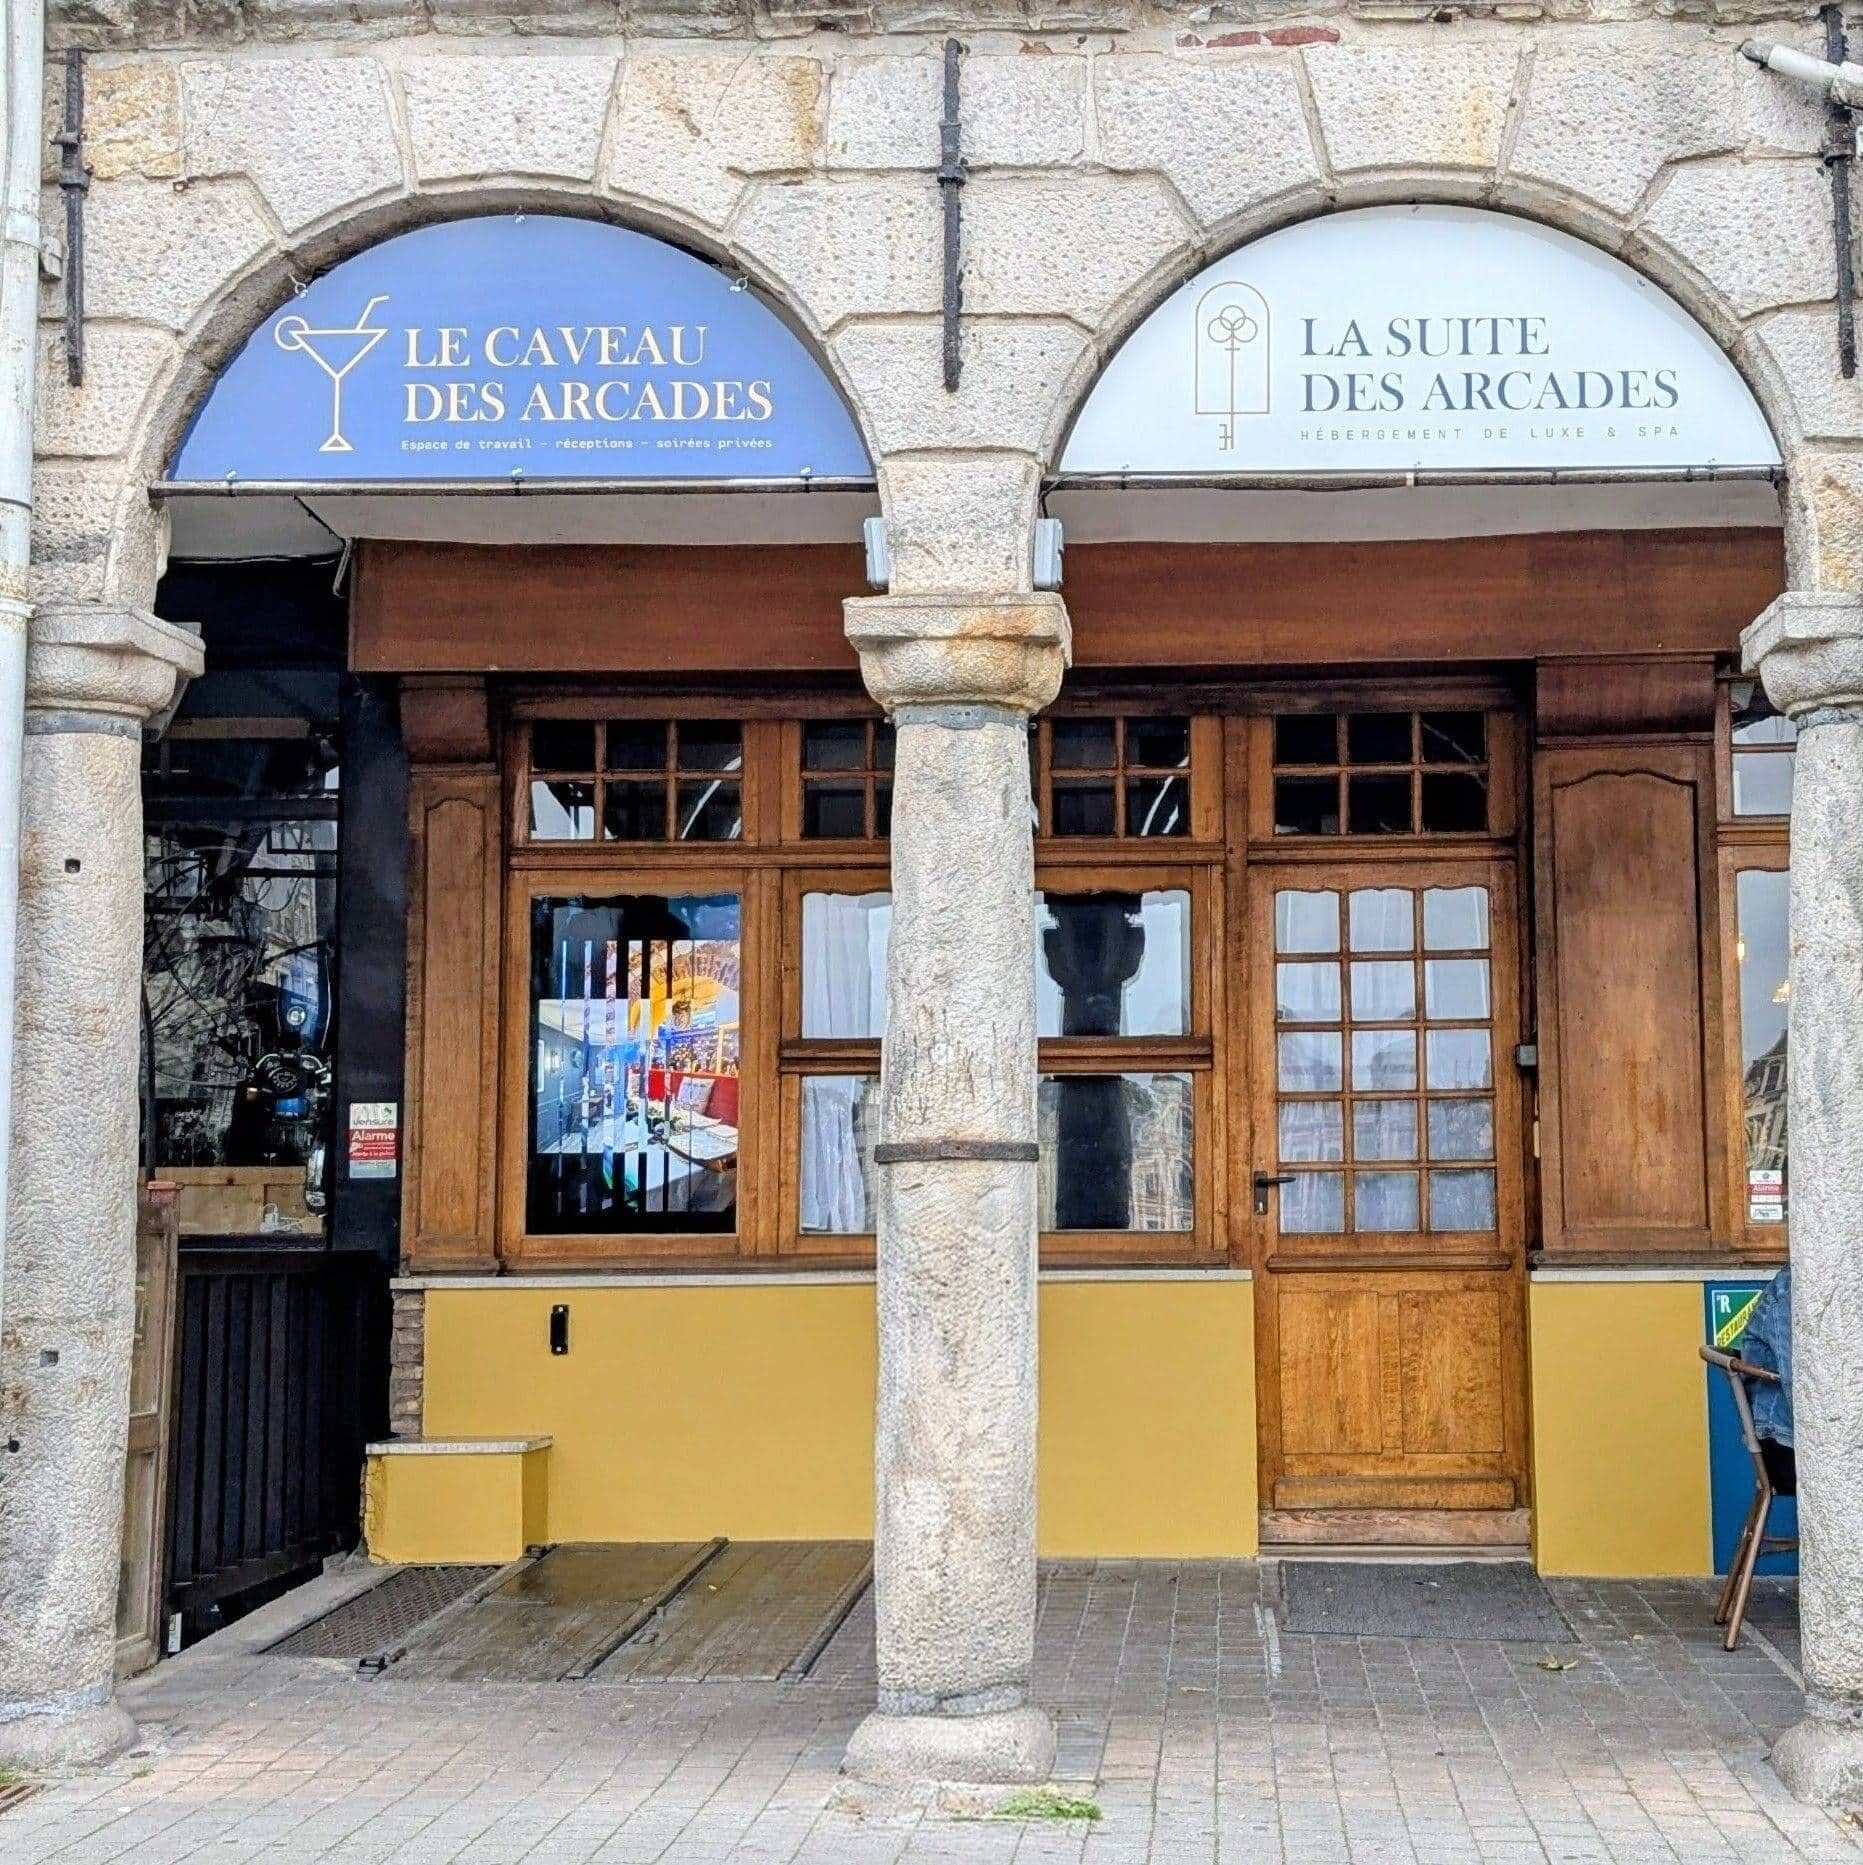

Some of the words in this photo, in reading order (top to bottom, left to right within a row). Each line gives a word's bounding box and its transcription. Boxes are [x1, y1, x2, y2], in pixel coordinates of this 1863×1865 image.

[404, 327, 470, 367] LE
[485, 325, 707, 367] CAVEAU
[1300, 318, 1373, 358] LA
[1387, 317, 1550, 358] SUITE
[403, 381, 505, 423] DES
[519, 379, 774, 422] ARCADES
[1300, 371, 1405, 412] DES
[1421, 369, 1680, 411] ARCADES
[401, 440, 448, 453] Espace
[456, 440, 471, 450] de
[479, 439, 532, 450] travail
[555, 439, 634, 452] réceptions
[656, 438, 712, 450] soirées
[718, 437, 773, 452] privées
[1300, 425, 1464, 441] HÉBERGEMENT
[1483, 427, 1508, 440] DE
[1529, 427, 1585, 440] LUXE
[1607, 427, 1617, 439] &
[1638, 426, 1680, 439] SPA
[352, 1130, 395, 1141] Alarme
